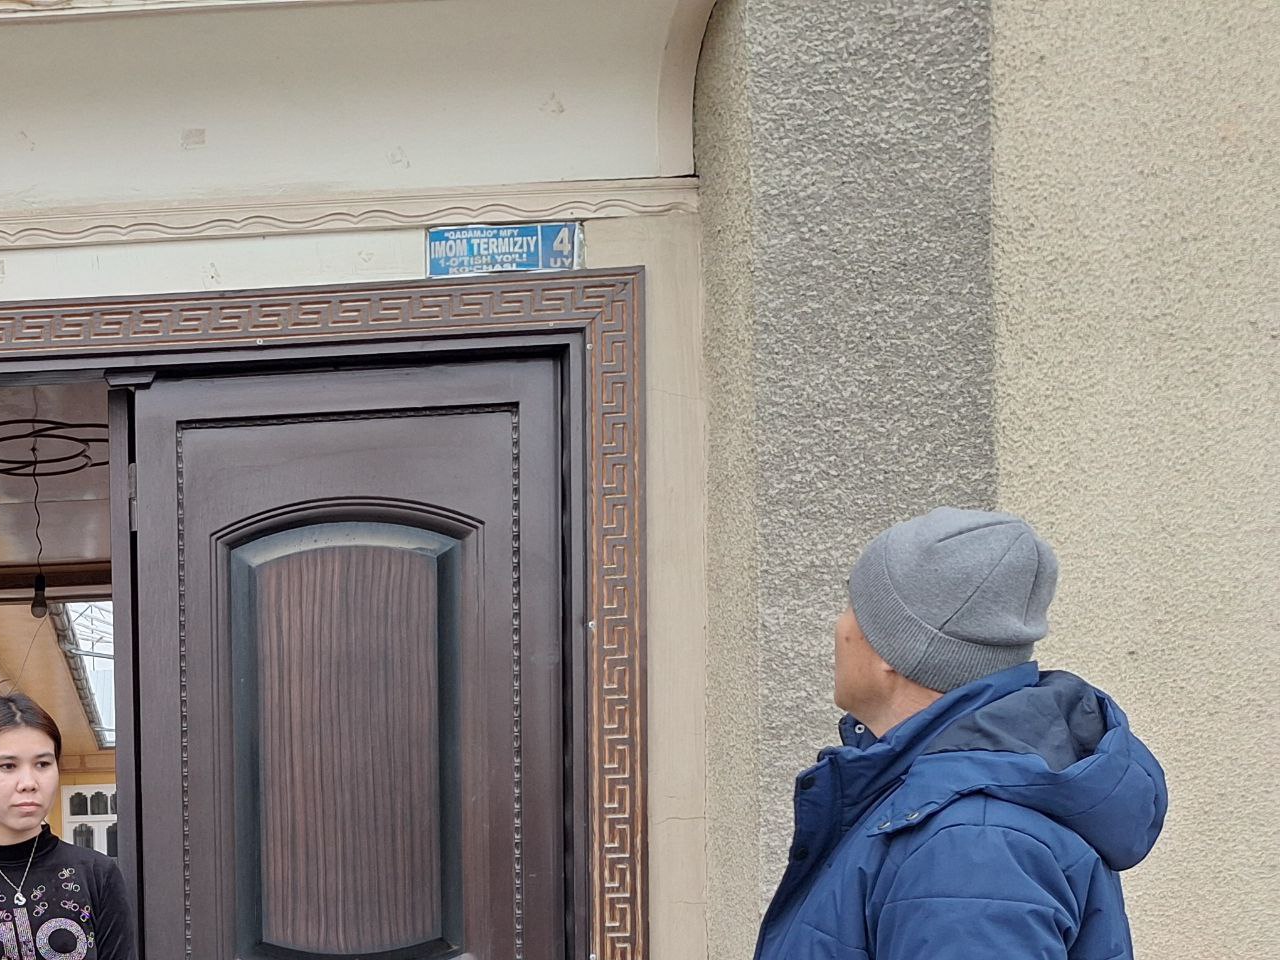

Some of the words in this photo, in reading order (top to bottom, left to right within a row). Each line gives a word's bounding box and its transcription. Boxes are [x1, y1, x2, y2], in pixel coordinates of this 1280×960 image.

[431, 239, 468, 260] IMOM
[471, 236, 537, 257] TERMIZIY
[553, 227, 571, 256] 4
[549, 257, 572, 268] UY
